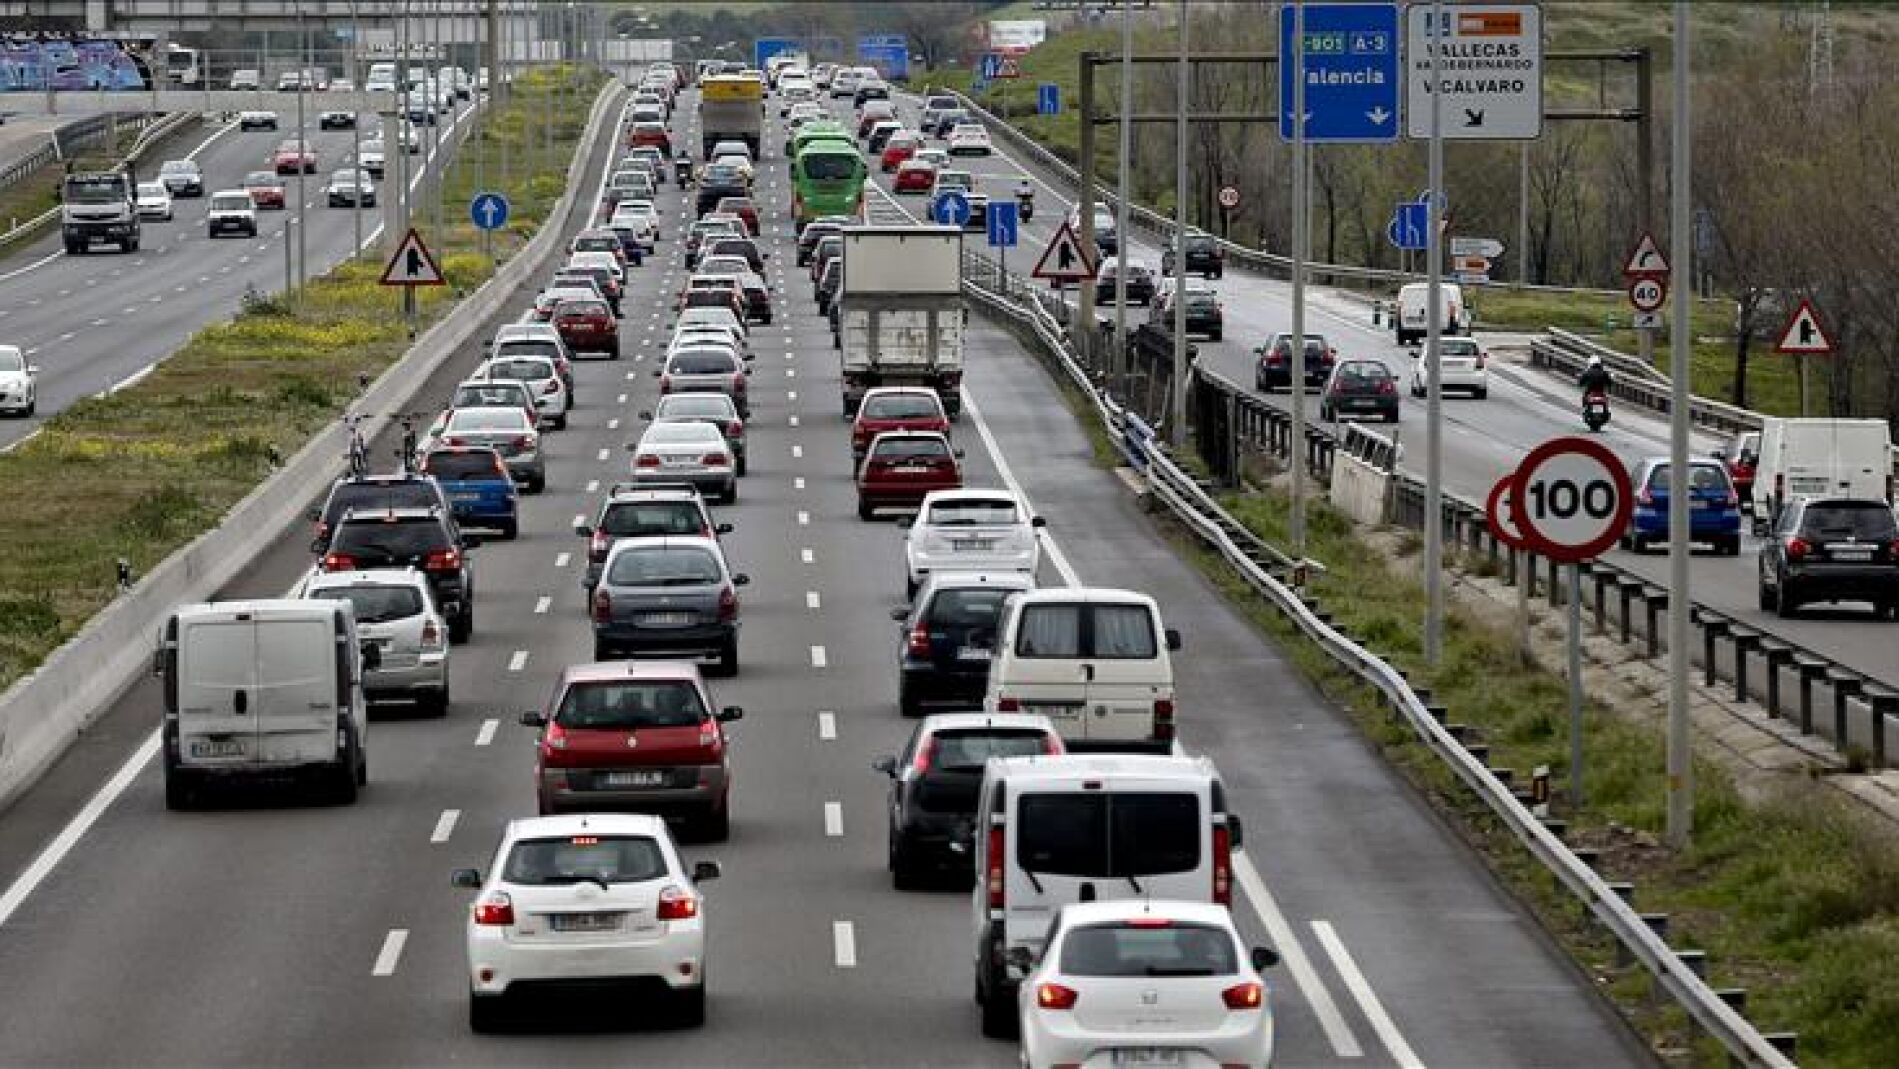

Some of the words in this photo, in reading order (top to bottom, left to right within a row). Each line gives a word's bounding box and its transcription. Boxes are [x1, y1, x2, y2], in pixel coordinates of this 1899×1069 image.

[1302, 67, 1384, 84] alencia
[1423, 80, 1524, 94] VCALVARO
[1636, 287, 1659, 300] 40
[1529, 479, 1615, 520] 100
